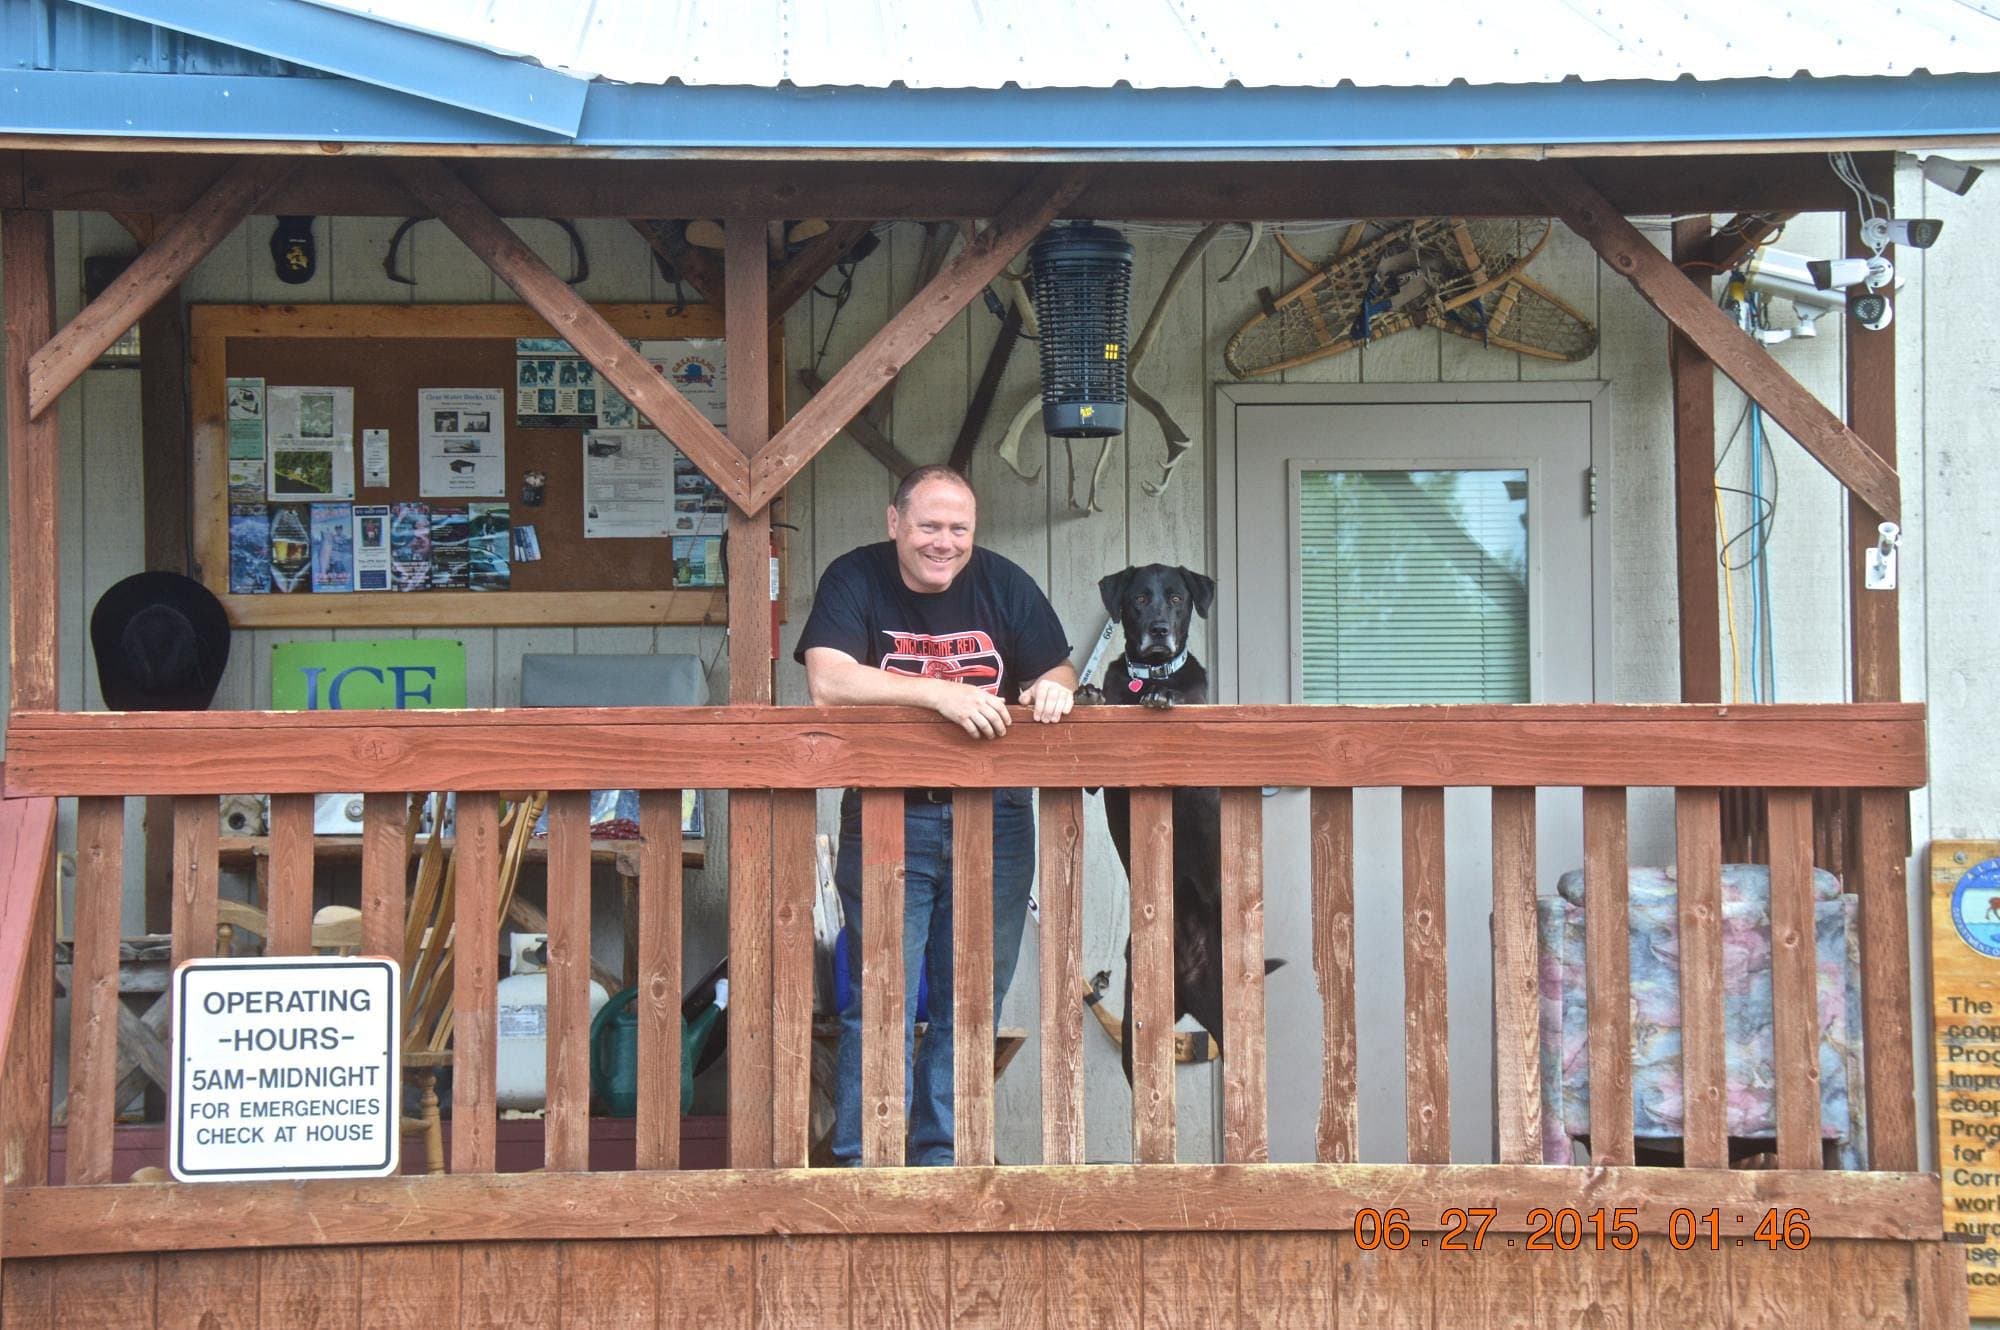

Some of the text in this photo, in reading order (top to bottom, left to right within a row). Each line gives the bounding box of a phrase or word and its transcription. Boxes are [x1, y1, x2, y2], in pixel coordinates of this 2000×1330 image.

[956, 637, 976, 655] RED
[300, 665, 437, 710] ICE
[203, 988, 371, 1015] OPERATING
[1947, 996, 1993, 1014] The
[218, 1026, 355, 1052] -HOURS-
[191, 1065, 380, 1091] 5AM-MIDNIGHT
[190, 1098, 380, 1120] FOR EMERGENCIES
[196, 1124, 373, 1145] CHECK AT HOUSE
[1952, 1144, 1986, 1162] for
